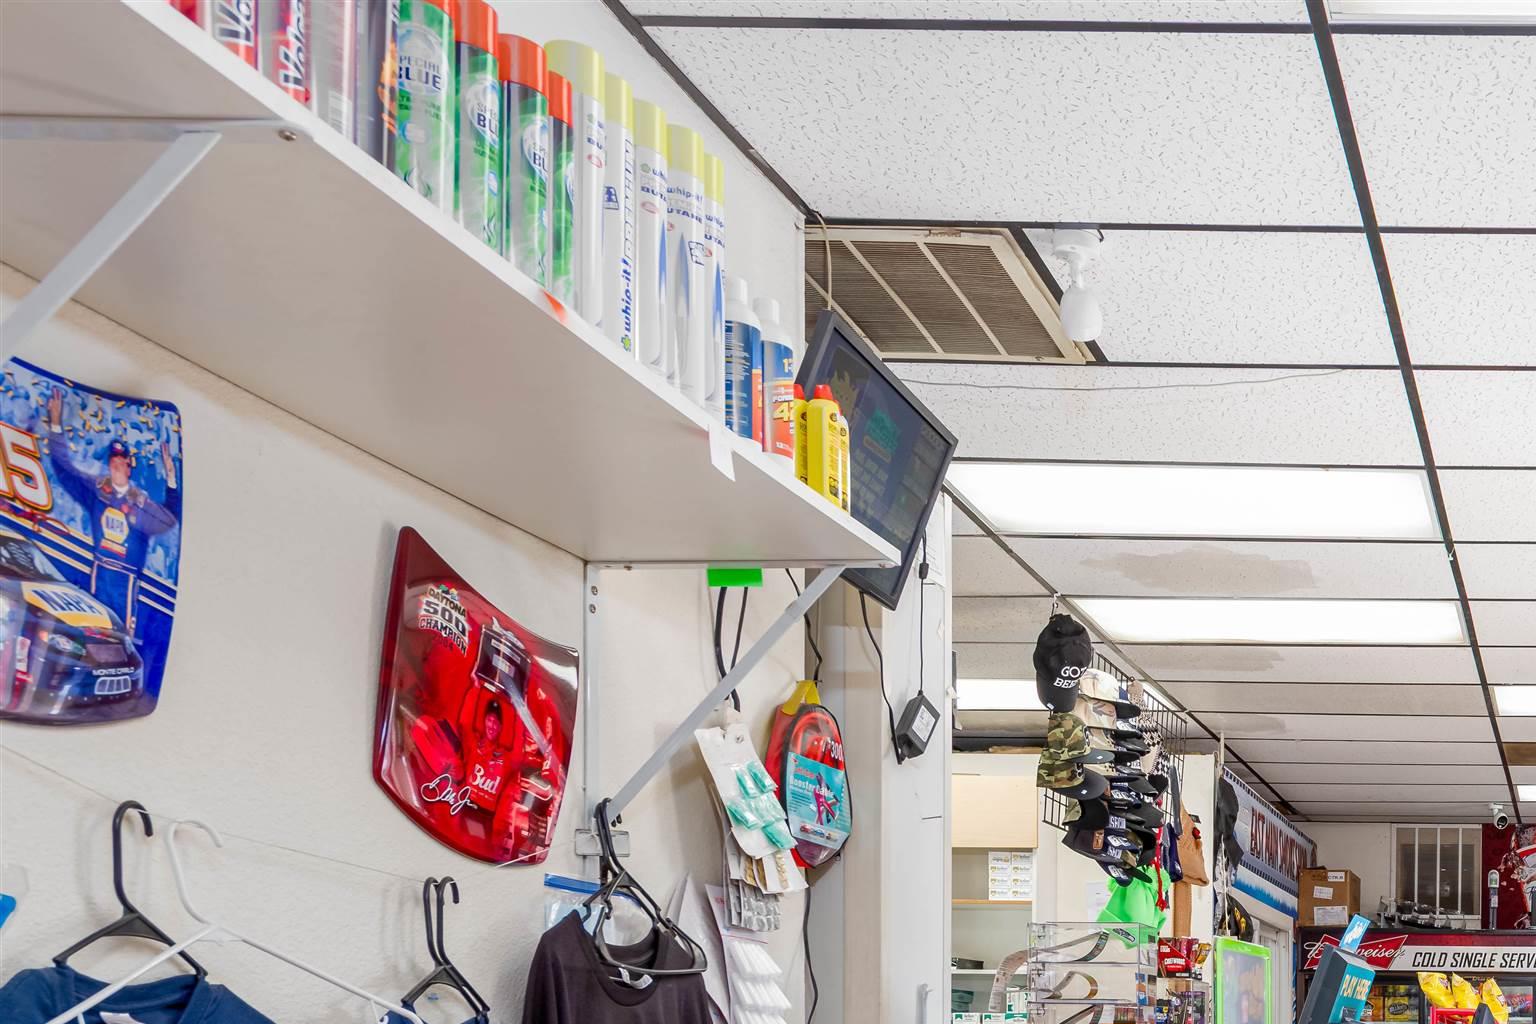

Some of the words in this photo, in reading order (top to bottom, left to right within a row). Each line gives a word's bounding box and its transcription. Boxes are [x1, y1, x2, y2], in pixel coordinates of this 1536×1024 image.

[422, 599, 468, 637] 500
[427, 586, 467, 618] DAYTONA
[418, 614, 469, 657] CHAMPION
[470, 763, 501, 795] Bud
[1412, 951, 1448, 968] COLD
[1450, 952, 1498, 969] SINGLE
